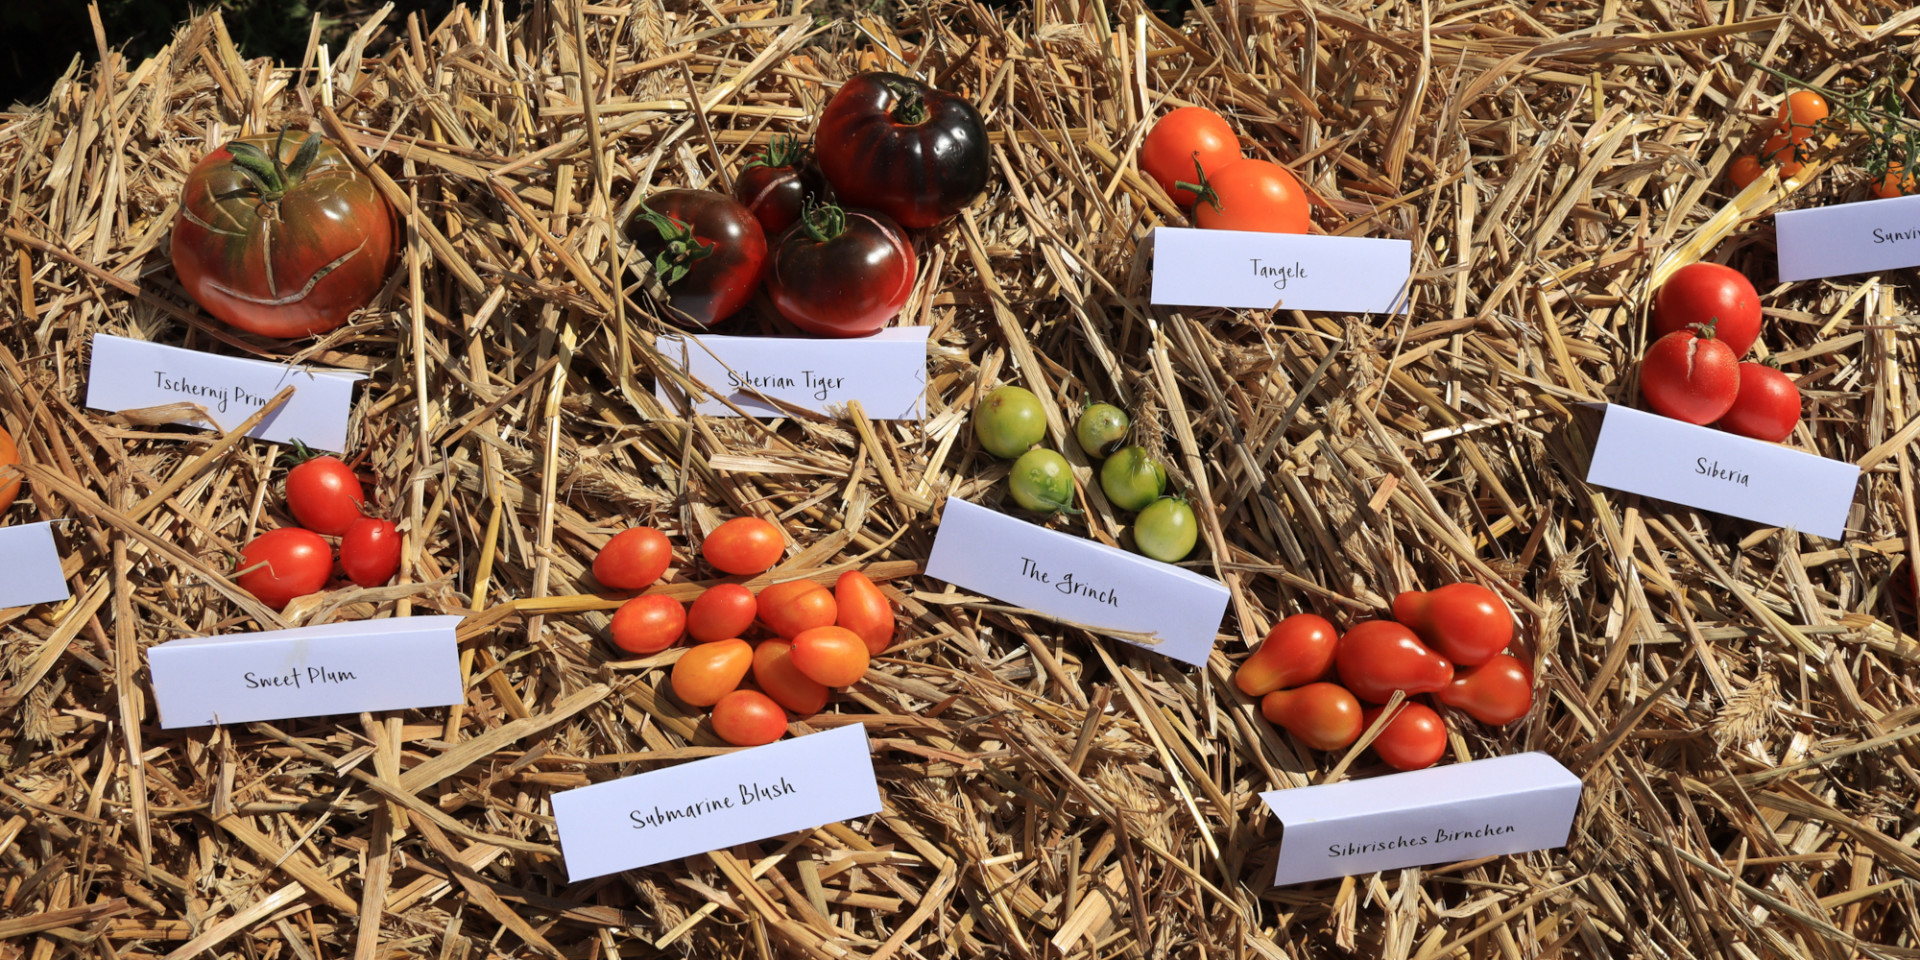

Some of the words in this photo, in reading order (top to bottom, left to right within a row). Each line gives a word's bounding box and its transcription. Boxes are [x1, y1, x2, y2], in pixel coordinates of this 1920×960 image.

[1249, 258, 1309, 290] Tangele
[154, 370, 228, 413] Tschernij
[235, 386, 273, 407] Prin
[727, 369, 796, 390] Siberian
[801, 370, 846, 401] Tiger
[1694, 456, 1750, 488] Siberia
[1021, 556, 1050, 584] The
[243, 667, 302, 689] Sweet
[307, 666, 357, 685] Plum
[629, 797, 735, 830] Submarine
[738, 776, 796, 806] Blush
[1327, 835, 1428, 858] Sibirisches
[1434, 823, 1515, 844] Birnchen
